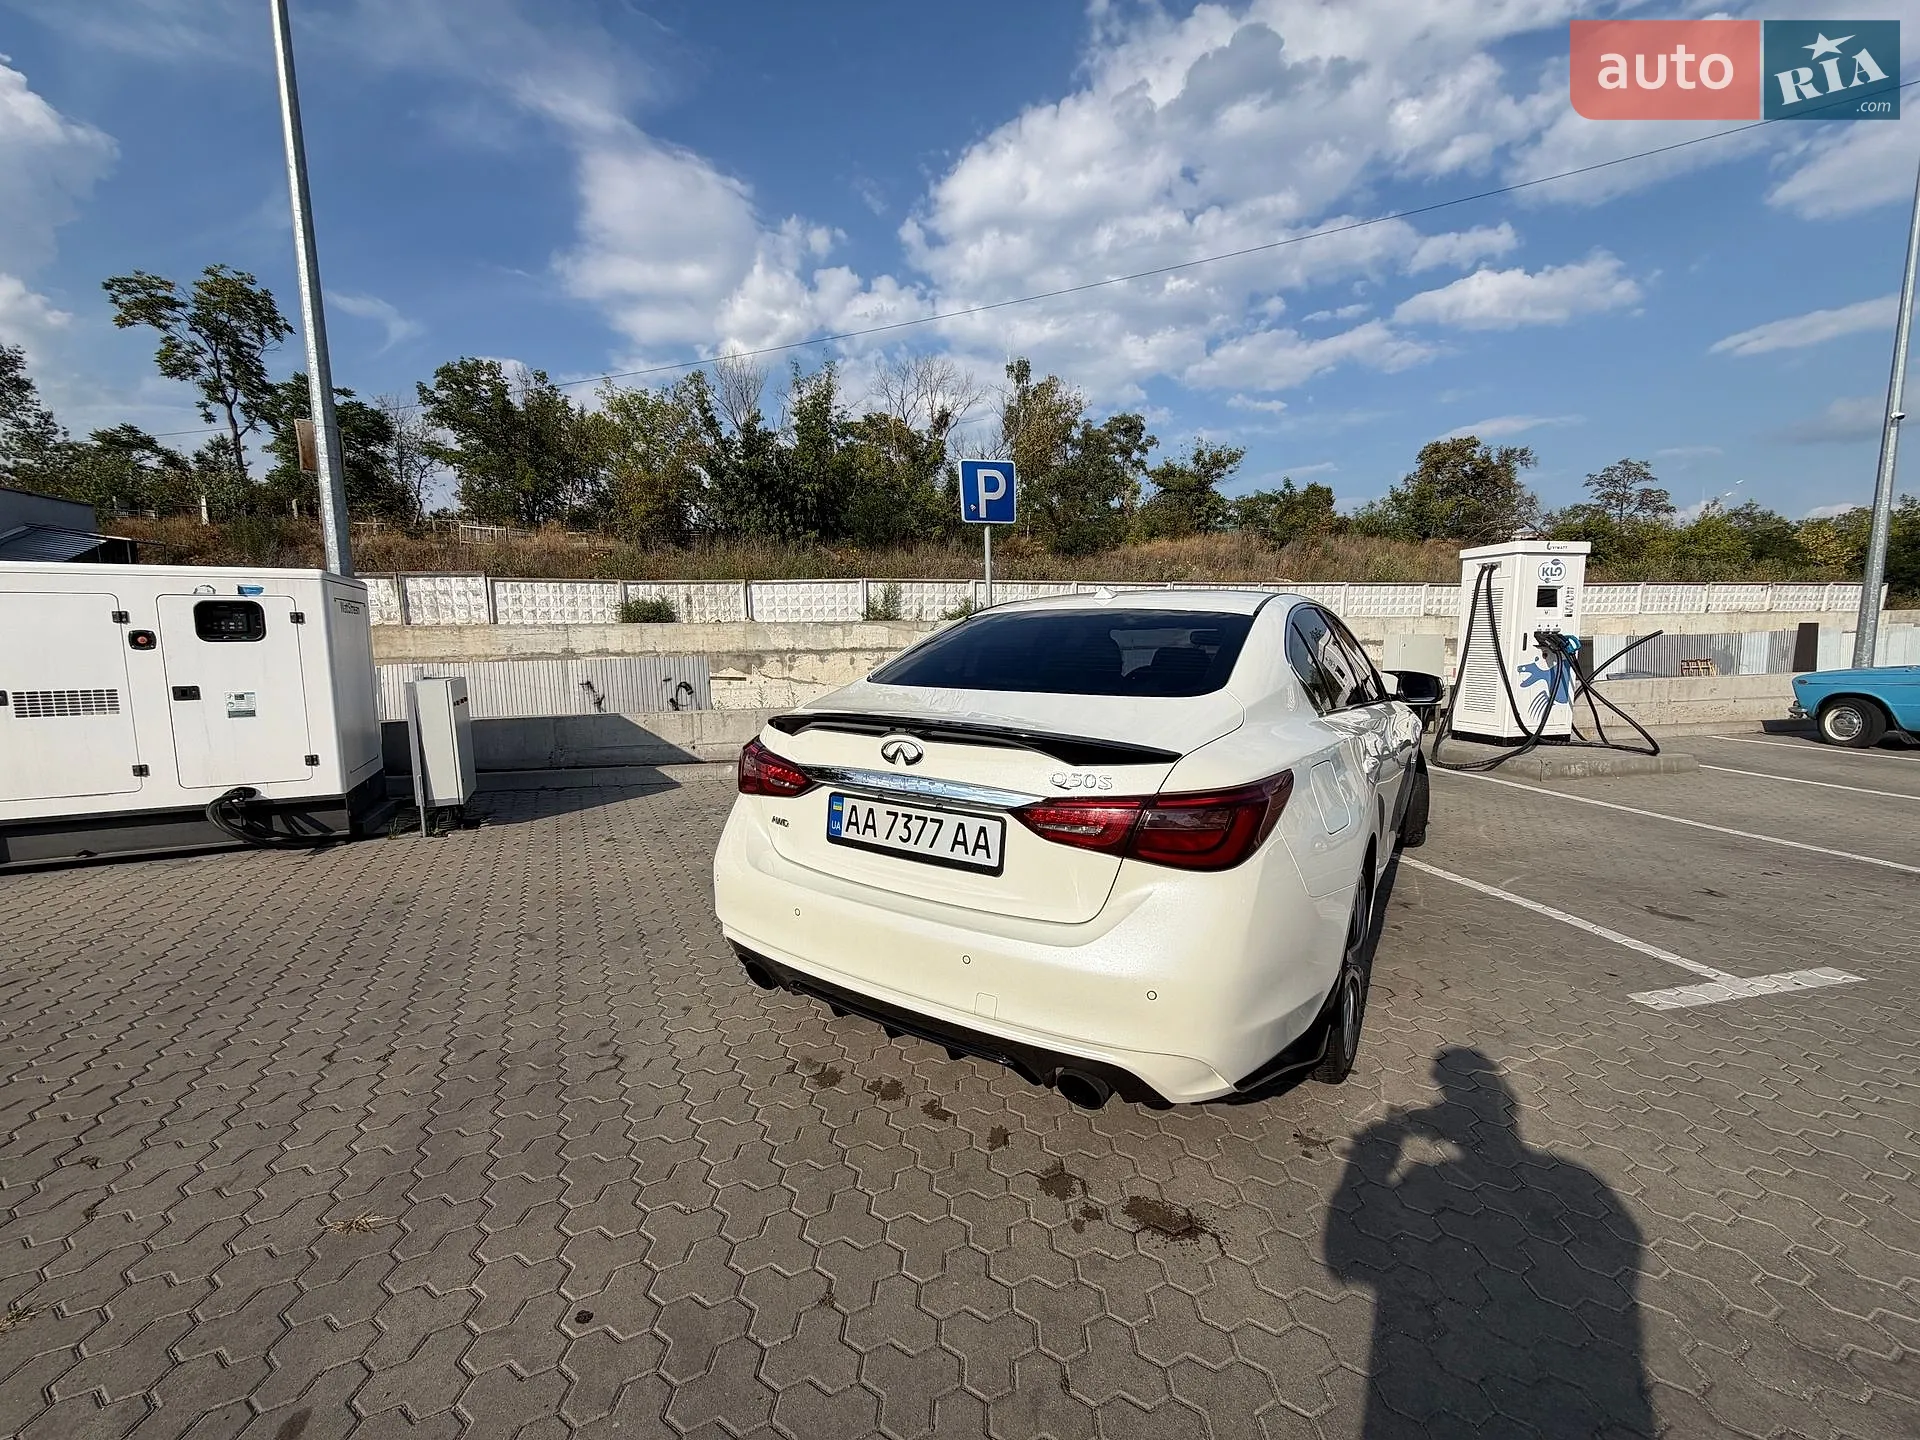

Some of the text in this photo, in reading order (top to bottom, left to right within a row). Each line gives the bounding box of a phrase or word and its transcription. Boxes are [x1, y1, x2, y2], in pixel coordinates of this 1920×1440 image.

[977, 469, 1007, 518] P
[1541, 566, 1563, 577] KLO
[1049, 772, 1113, 790] Q50S
[831, 820, 841, 831] UA
[845, 804, 992, 860] AA 7377 AA
